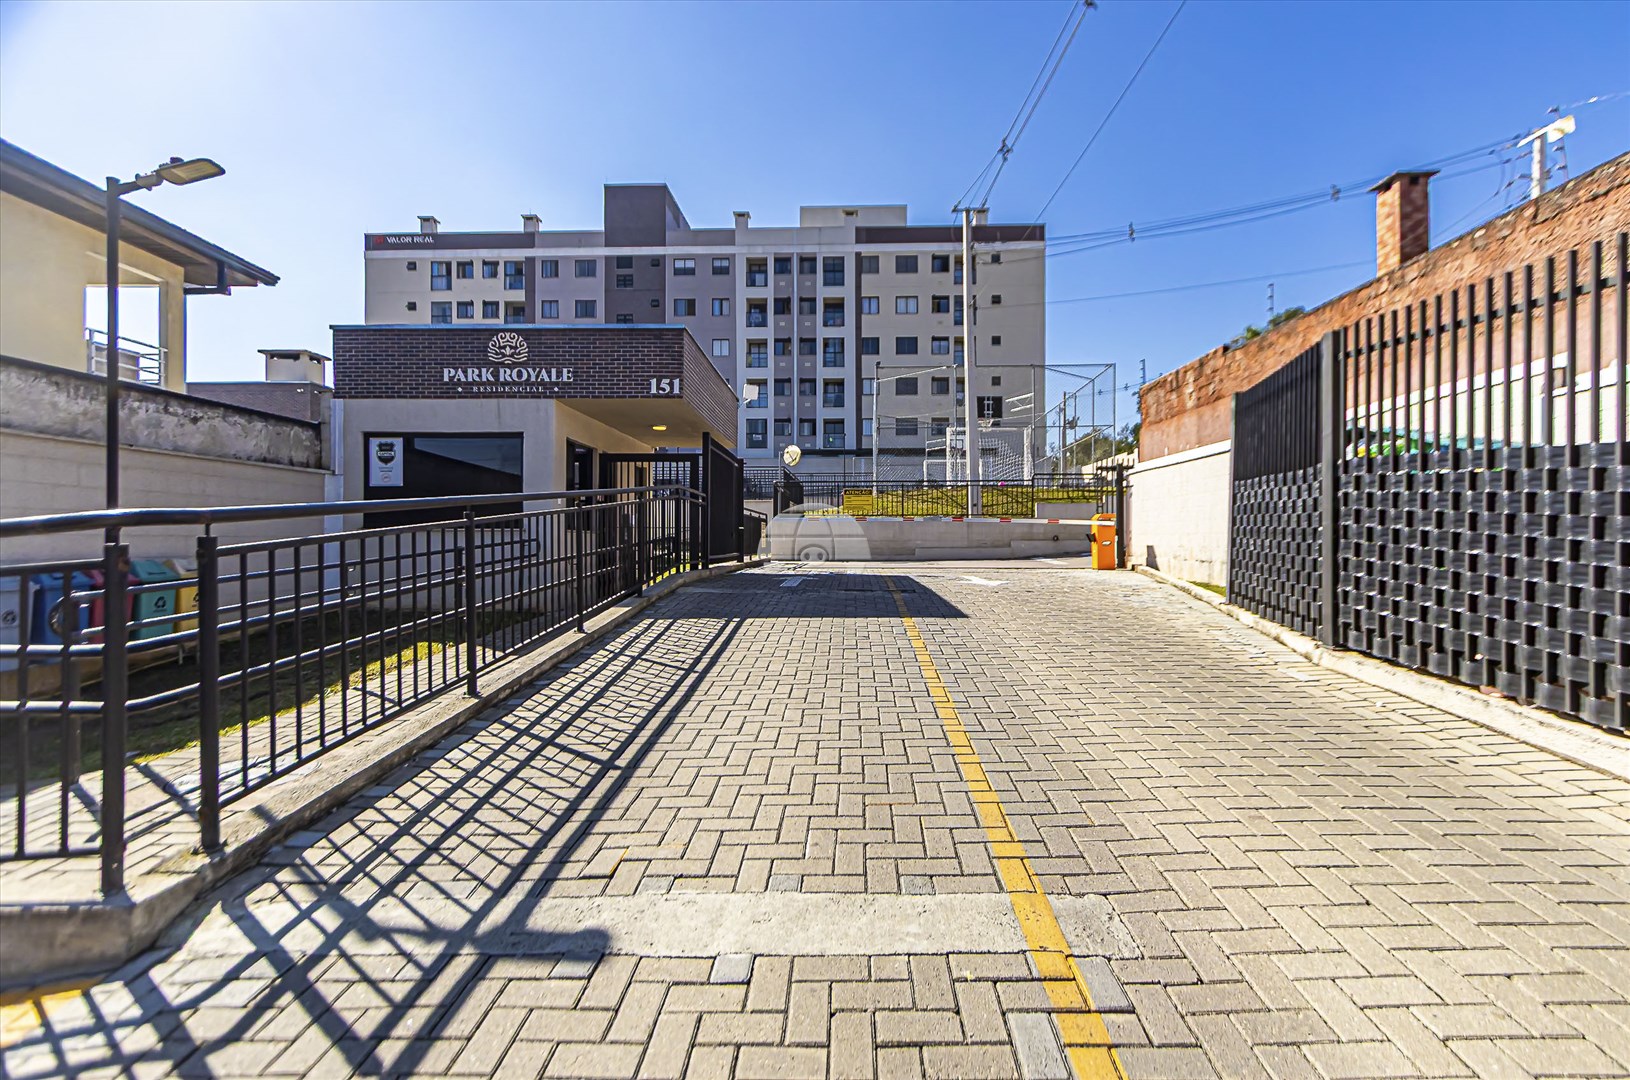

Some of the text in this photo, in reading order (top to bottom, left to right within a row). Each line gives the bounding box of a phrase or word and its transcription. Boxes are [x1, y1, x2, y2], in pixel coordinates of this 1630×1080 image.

[443, 368, 573, 381] PARK ROYALE
[650, 378, 680, 393] 151
